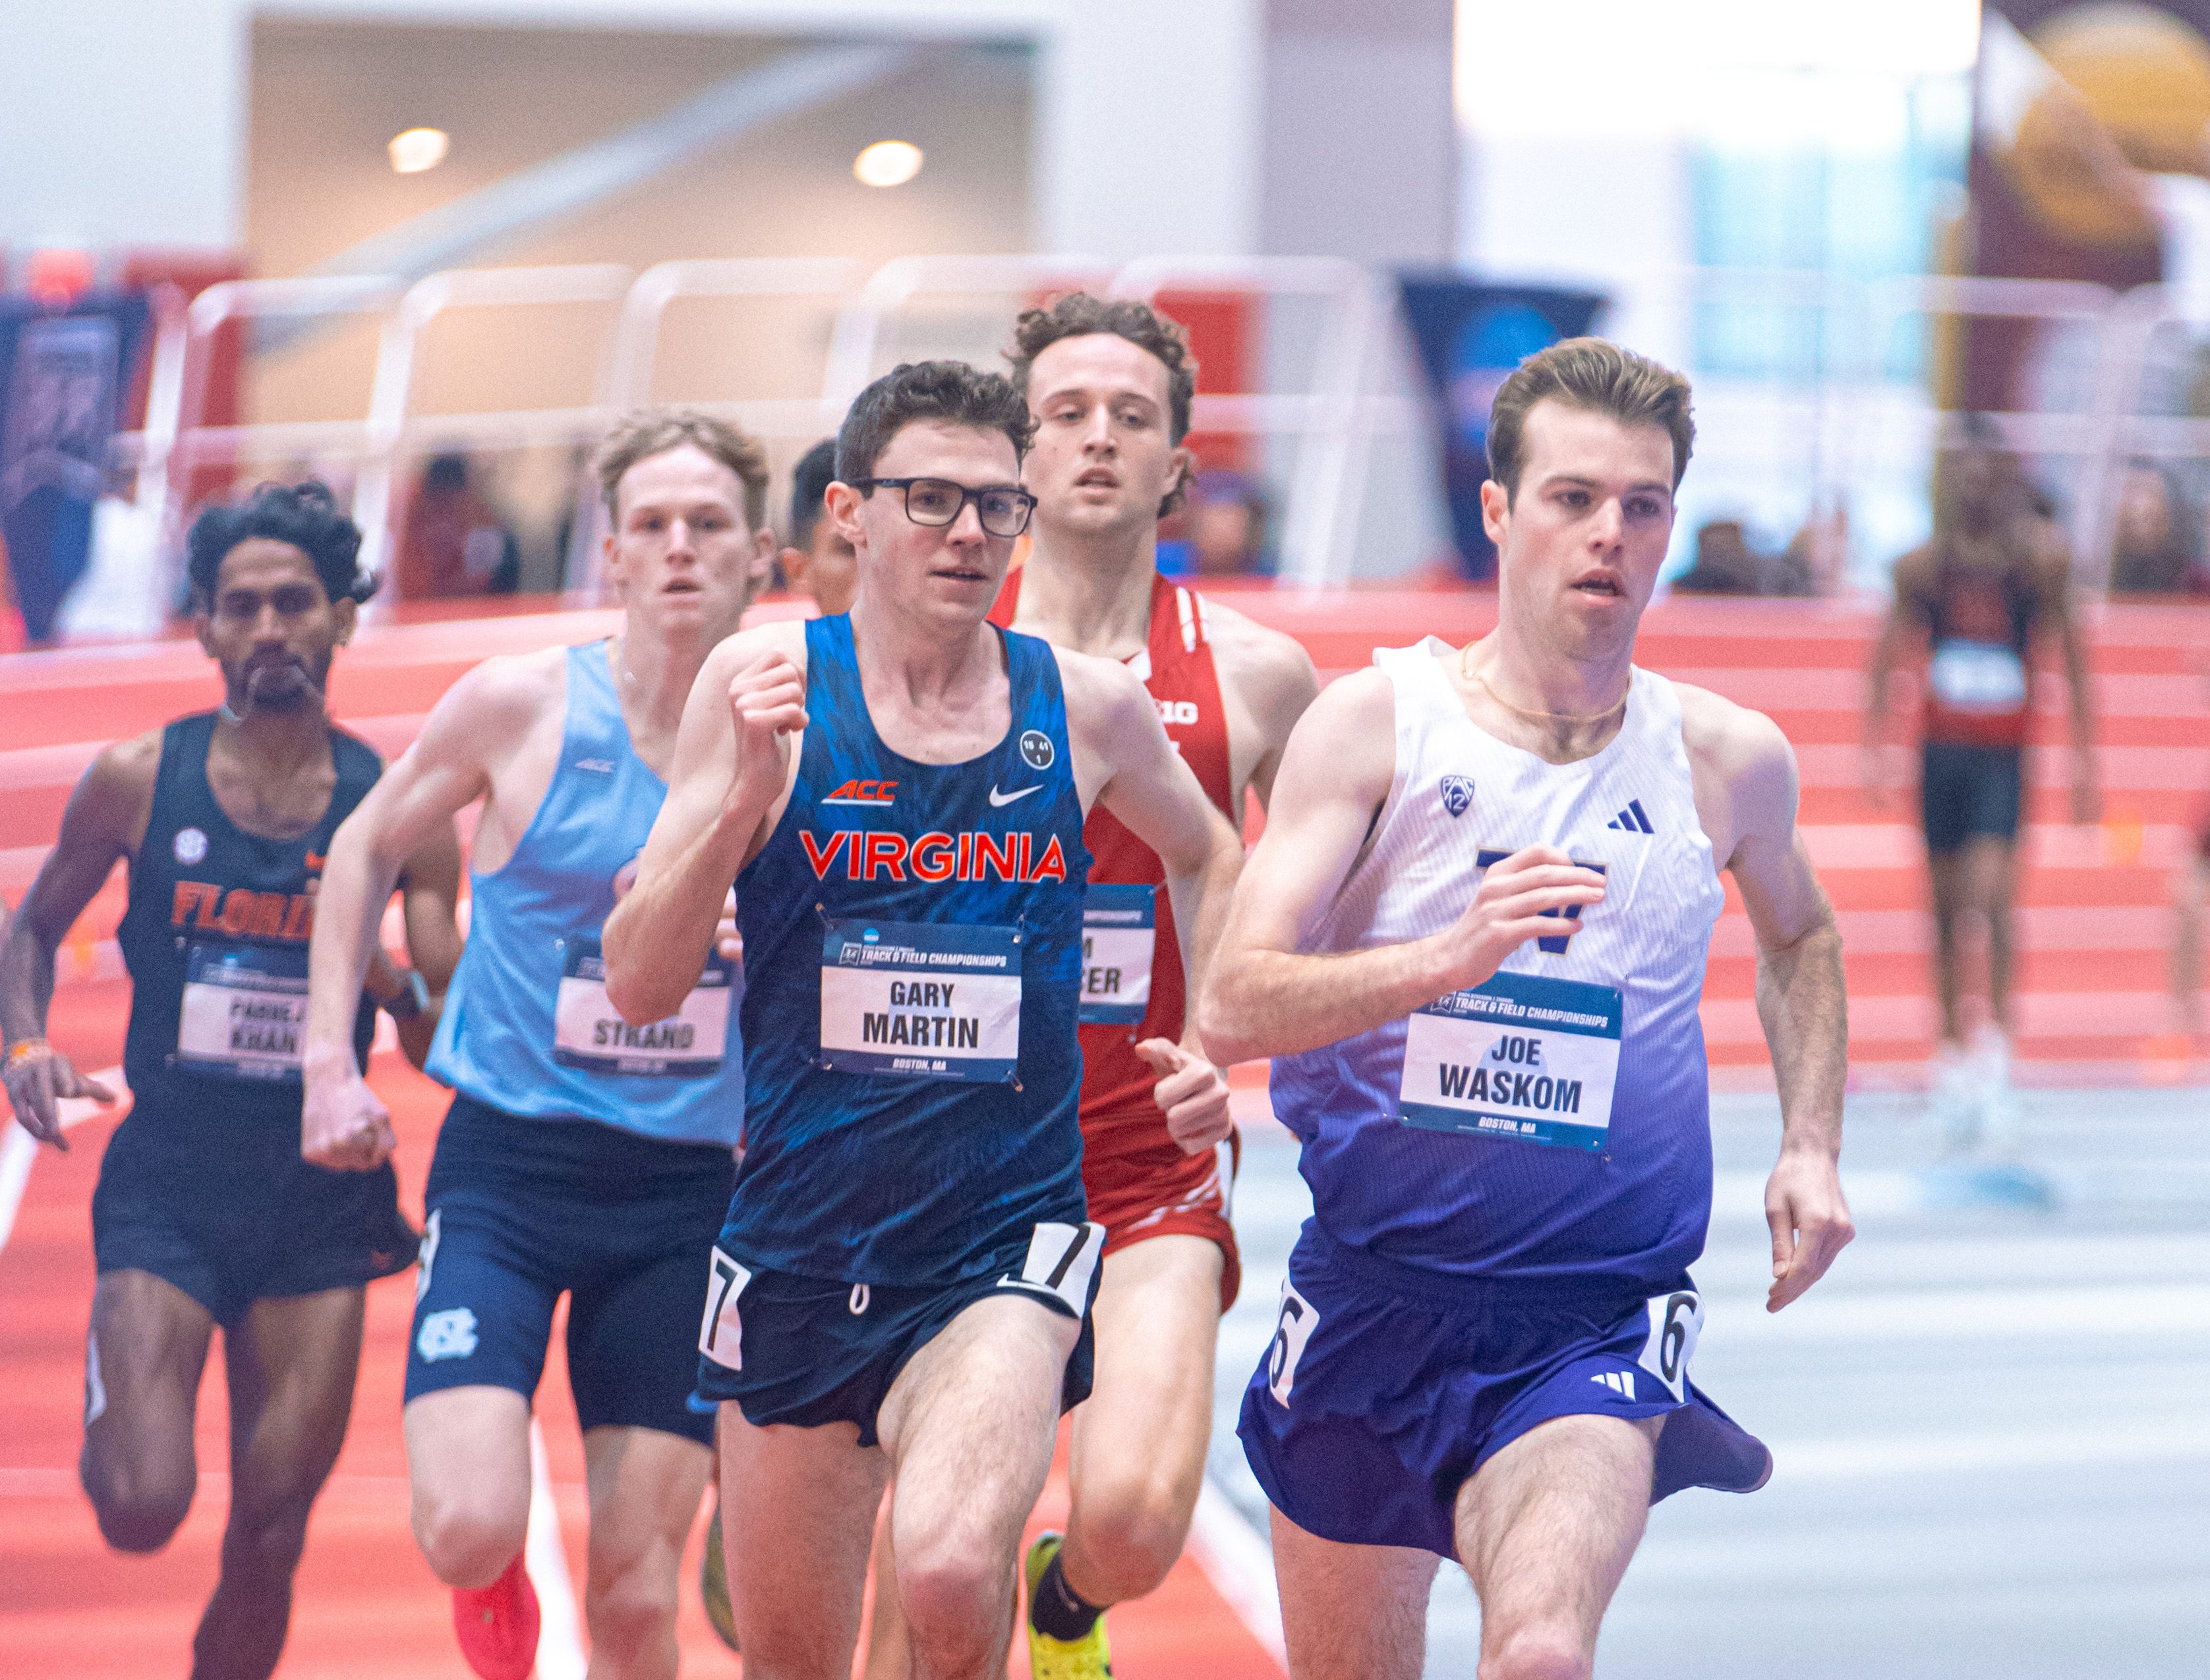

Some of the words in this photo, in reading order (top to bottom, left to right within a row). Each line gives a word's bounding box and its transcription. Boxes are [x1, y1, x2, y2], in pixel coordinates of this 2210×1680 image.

[828, 779, 898, 801] ACC
[1448, 793, 1465, 809] 12
[798, 830, 1066, 884] VIRGINIA
[861, 949, 892, 963] TRACK
[900, 952, 927, 964] FIELD
[928, 953, 1006, 968] CHAMPIONSHIPS
[890, 981, 955, 1008] GARY
[1082, 967, 1120, 994] ER
[1455, 997, 1489, 1012] TRACK
[1488, 1001, 1498, 1014] &
[1497, 1002, 1527, 1018] FIELD
[1527, 1007, 1609, 1028] CHAMPIONSHIPS
[863, 1012, 978, 1049] MARTIN
[1492, 1035, 1542, 1066] JOE
[931, 1061, 946, 1072] MA
[1440, 1063, 1583, 1114] WASKOM
[1478, 1116, 1519, 1132] BOSTON,
[1521, 1122, 1536, 1134] MA
[1045, 1224, 1091, 1290] 7
[707, 1258, 738, 1351] 7
[1271, 1296, 1304, 1389] 6
[1660, 1292, 1697, 1383] 6
